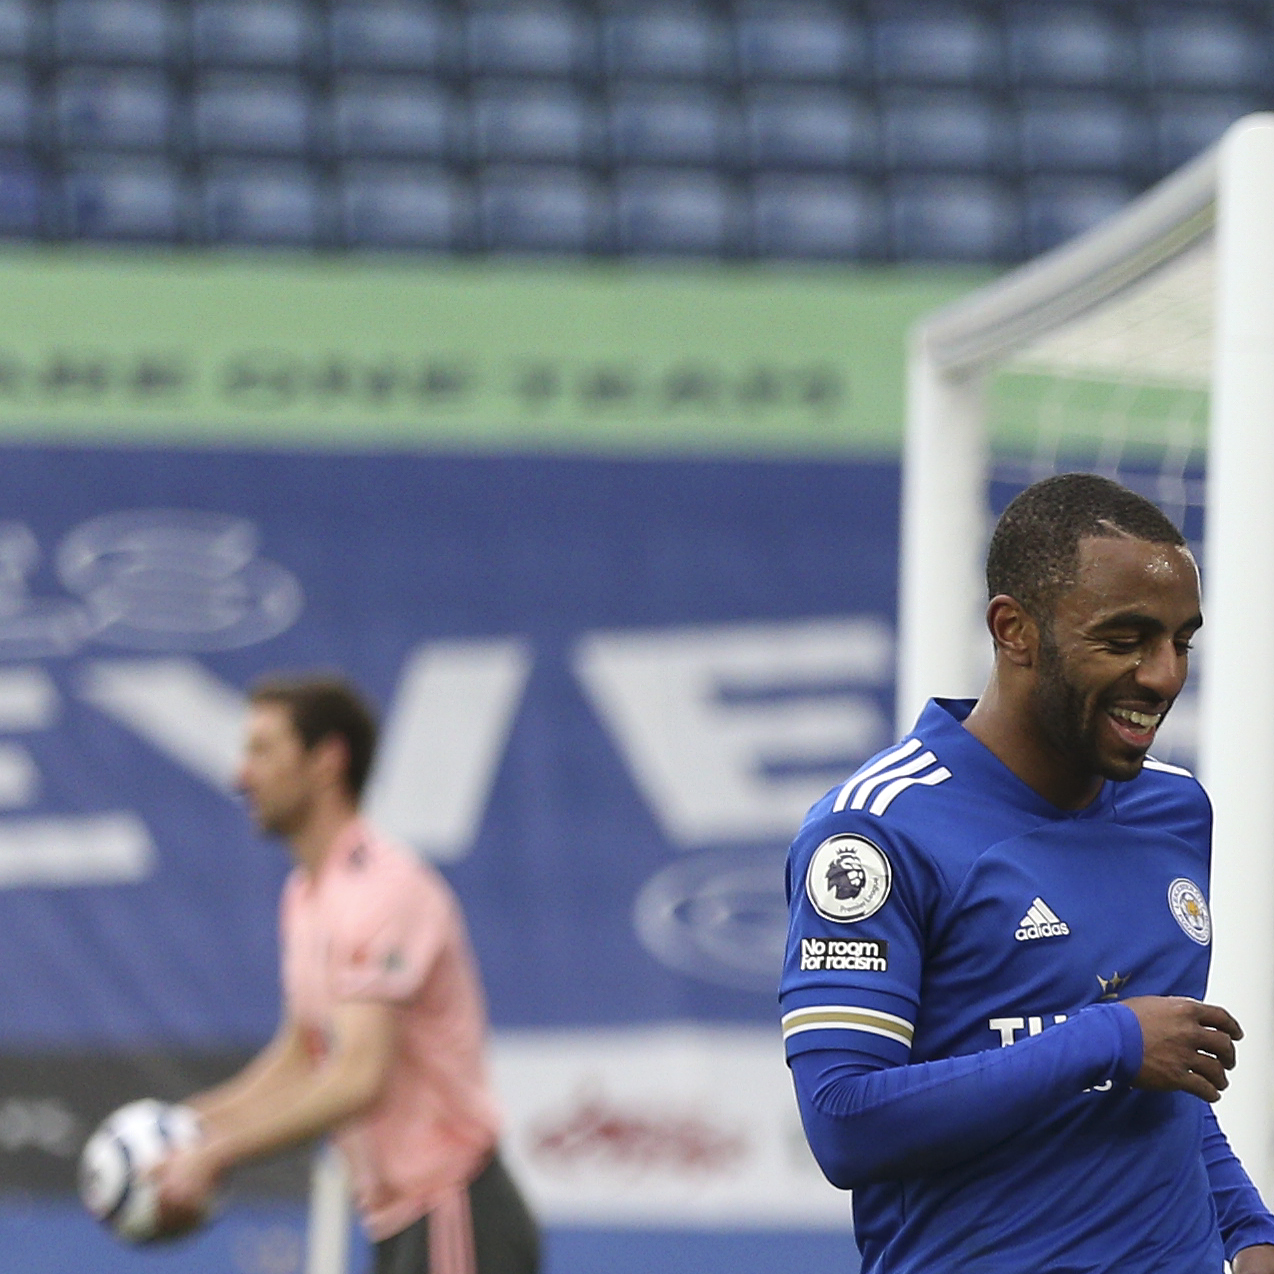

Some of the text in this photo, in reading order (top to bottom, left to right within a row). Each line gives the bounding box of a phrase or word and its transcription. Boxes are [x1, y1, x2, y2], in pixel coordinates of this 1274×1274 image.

[1014, 922, 1070, 941] adidas
[801, 938, 879, 957] No room
[826, 956, 887, 972] racism
